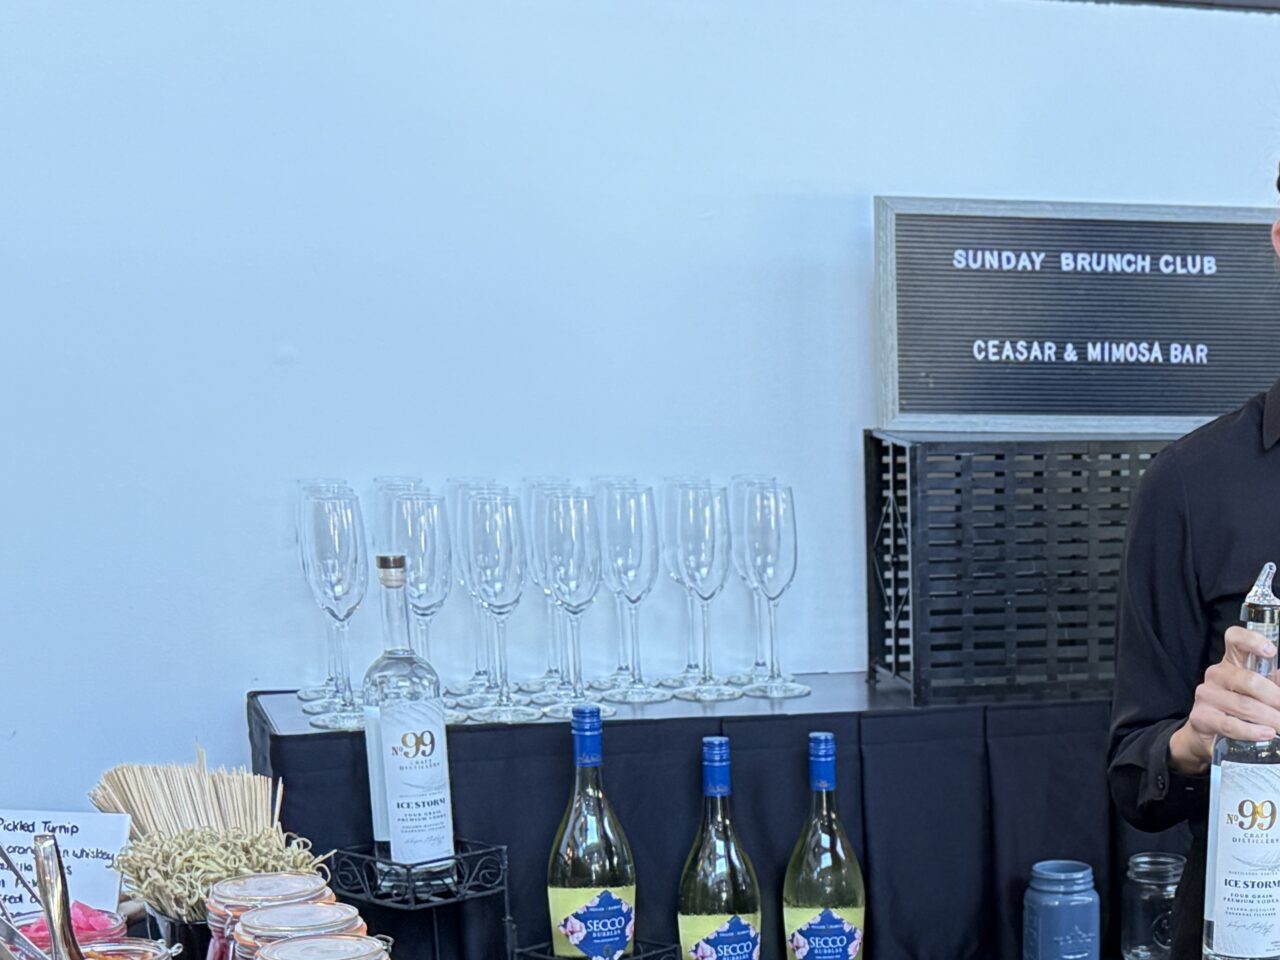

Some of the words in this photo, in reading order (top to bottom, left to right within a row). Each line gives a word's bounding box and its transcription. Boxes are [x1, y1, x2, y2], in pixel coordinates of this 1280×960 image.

[952, 249, 1046, 271] SUNDAY
[1060, 252, 1151, 273] BRUNCH
[1159, 254, 1218, 276] CLUB
[972, 340, 1056, 362] CEASAR
[1063, 343, 1078, 361] &
[1087, 341, 1163, 363] MIMOSA
[1169, 343, 1209, 364] BAR
[401, 730, 435, 758] 99
[415, 797, 446, 808] STORM
[1238, 799, 1277, 831] 99
[42, 820, 79, 836] Turnip
[1224, 878, 1240, 888] ICE
[1242, 880, 1280, 889] STORM
[586, 916, 625, 932] SECCO
[717, 941, 752, 957] SECCO
[809, 936, 847, 948] SECCO
